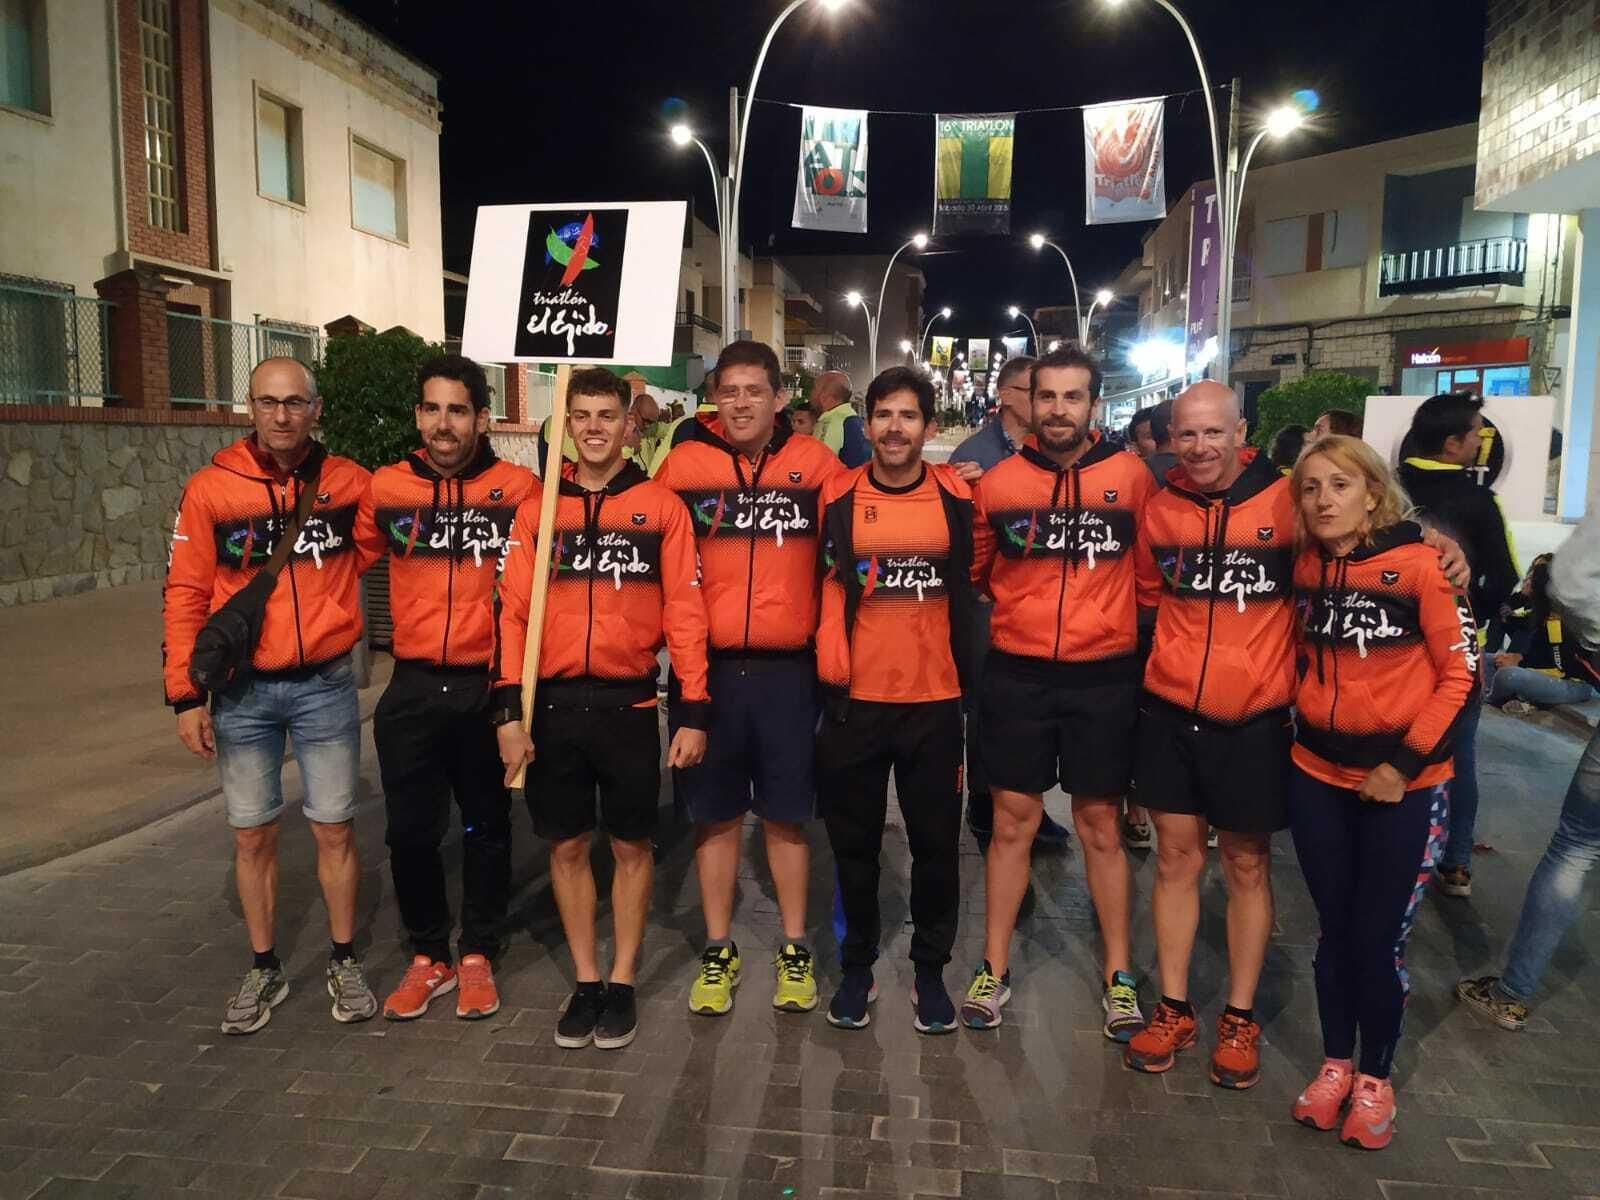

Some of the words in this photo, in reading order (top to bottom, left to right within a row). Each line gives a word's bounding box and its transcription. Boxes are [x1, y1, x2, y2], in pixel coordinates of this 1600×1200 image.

[961, 119, 1014, 132] TRIATLON
[533, 288, 587, 305] triatlón
[527, 307, 551, 335] el
[551, 303, 609, 356] Ejido
[294, 522, 344, 569] Ejido
[760, 503, 809, 548] Ejido
[597, 546, 650, 591] Ejido
[885, 568, 903, 588] el
[903, 566, 943, 602] Ejido
[887, 555, 930, 568] triatlón
[1192, 566, 1212, 591] el
[1219, 564, 1276, 613] Ejido
